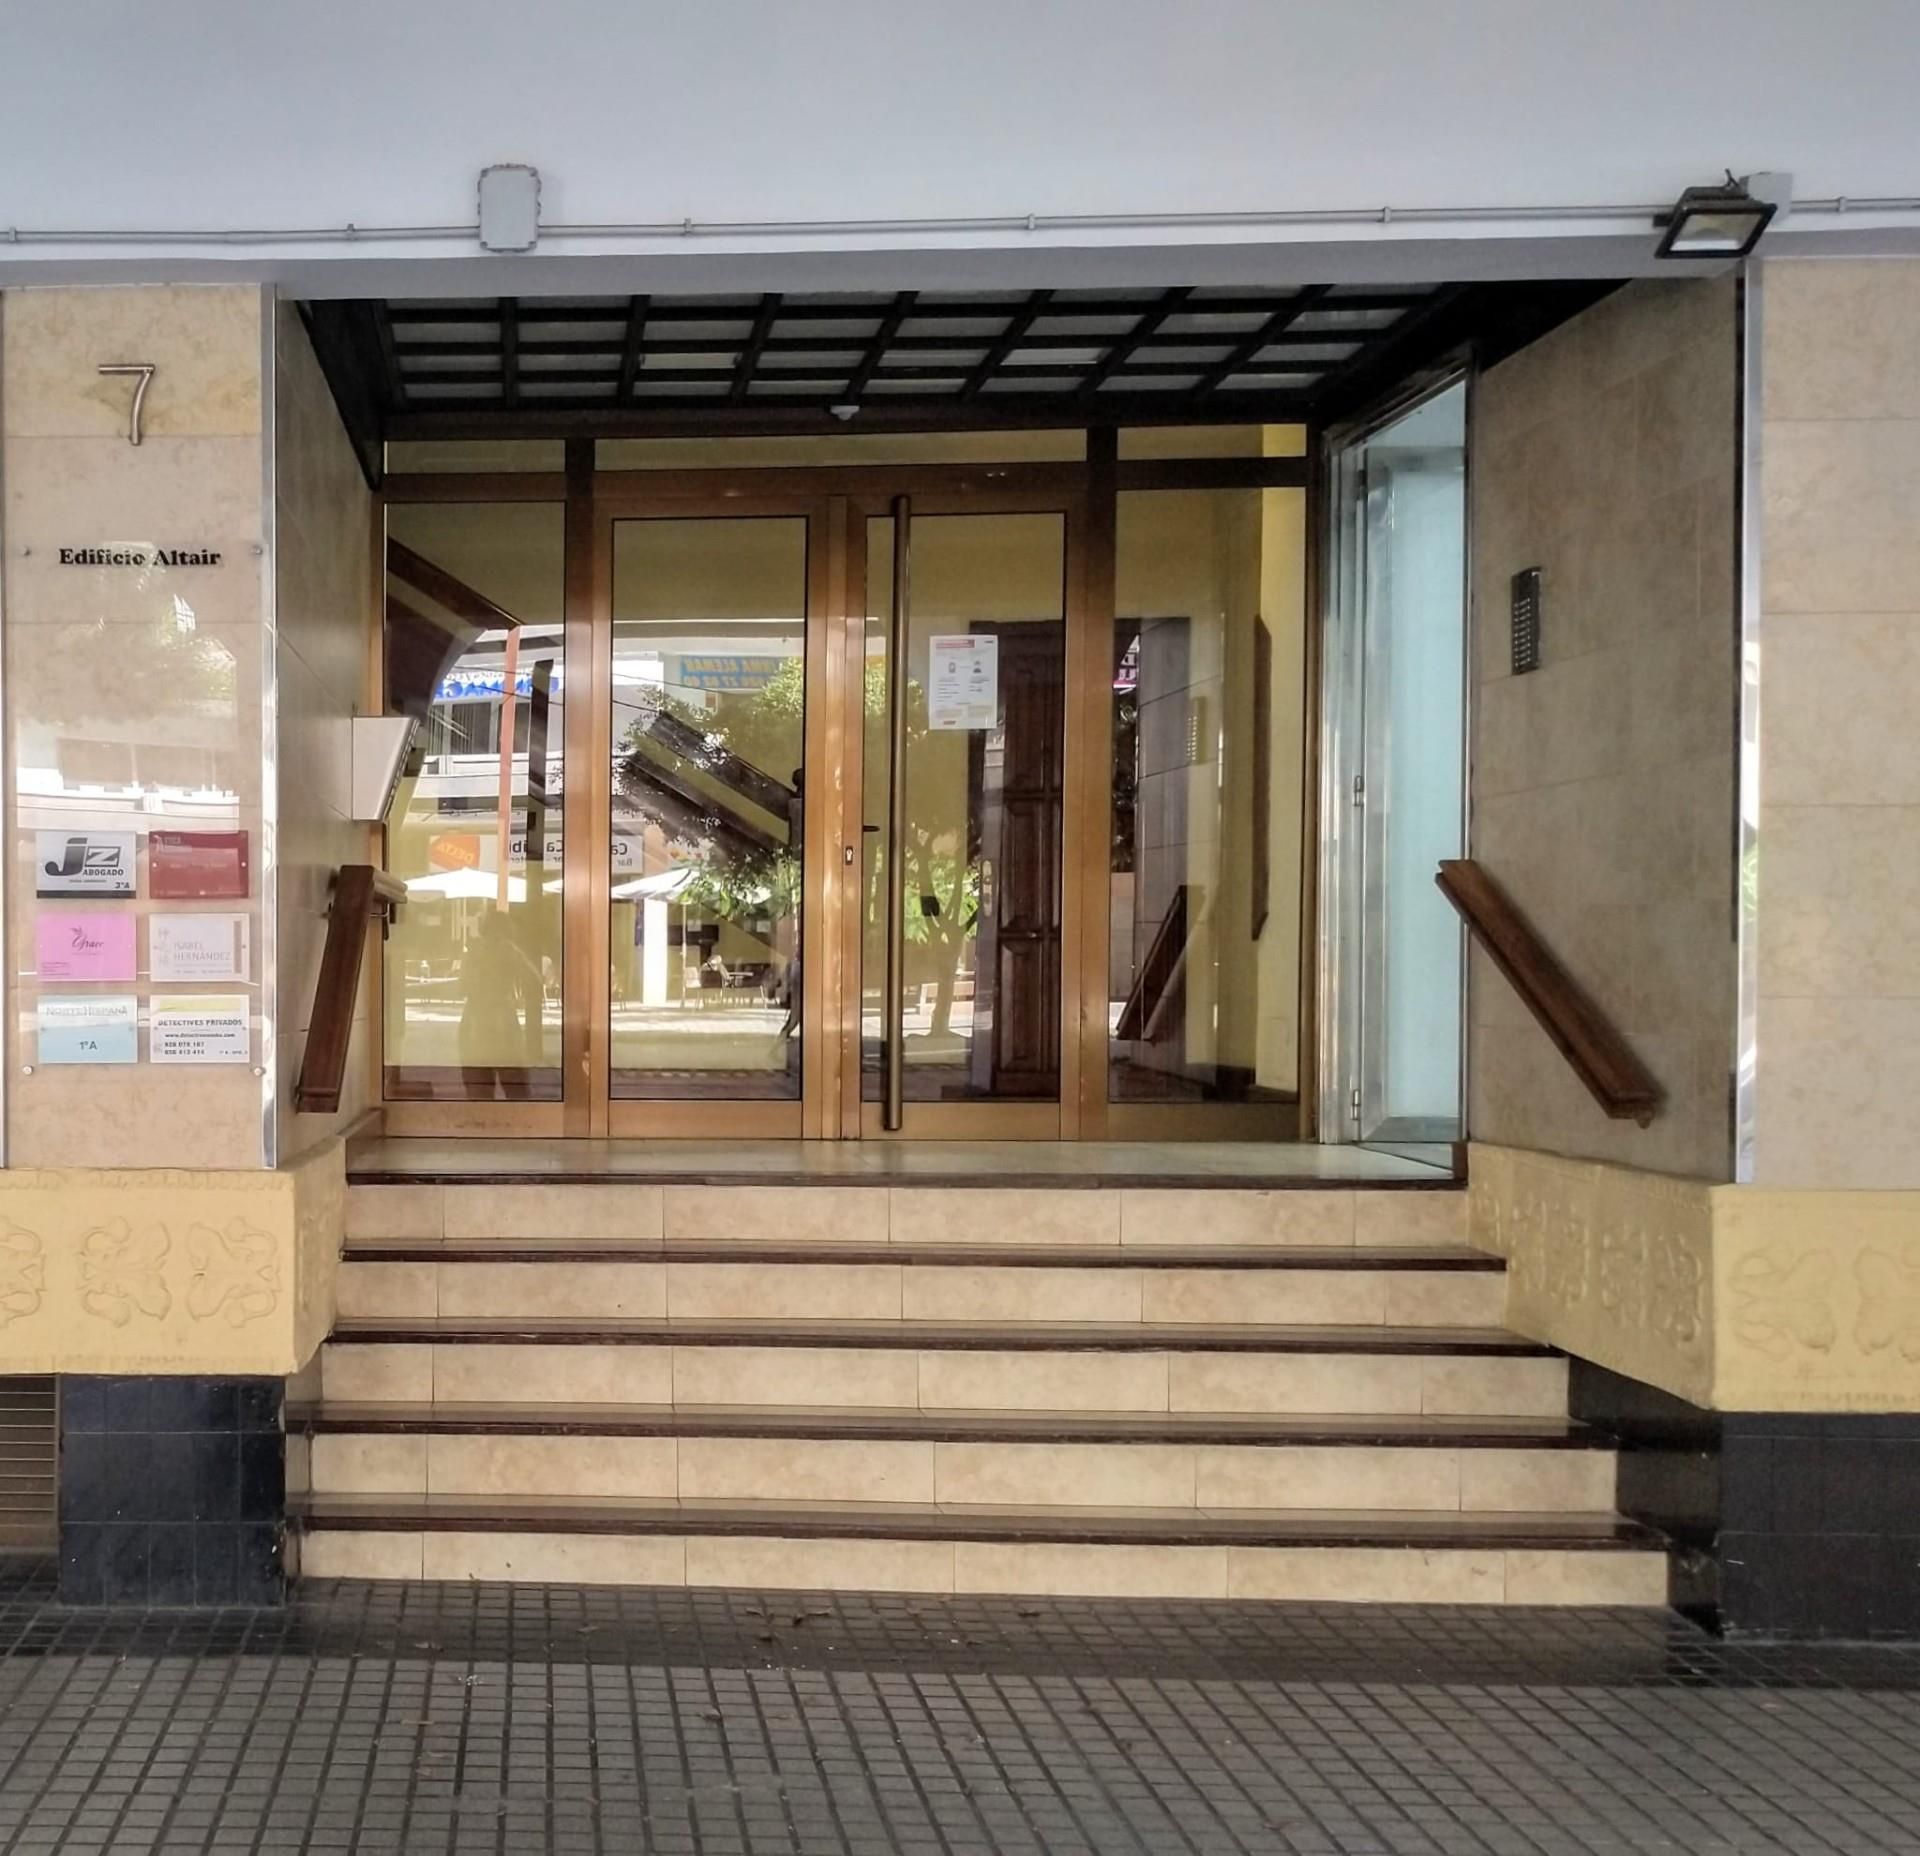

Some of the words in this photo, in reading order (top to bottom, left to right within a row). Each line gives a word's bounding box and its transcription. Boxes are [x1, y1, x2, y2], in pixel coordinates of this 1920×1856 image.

[98, 364, 155, 446] 7
[58, 548, 147, 565] Edificio
[152, 549, 222, 566] Altair
[82, 868, 125, 877] ABOGADO
[158, 1019, 205, 1027] DETECTIVES
[205, 1018, 243, 1027] PRIVADOS
